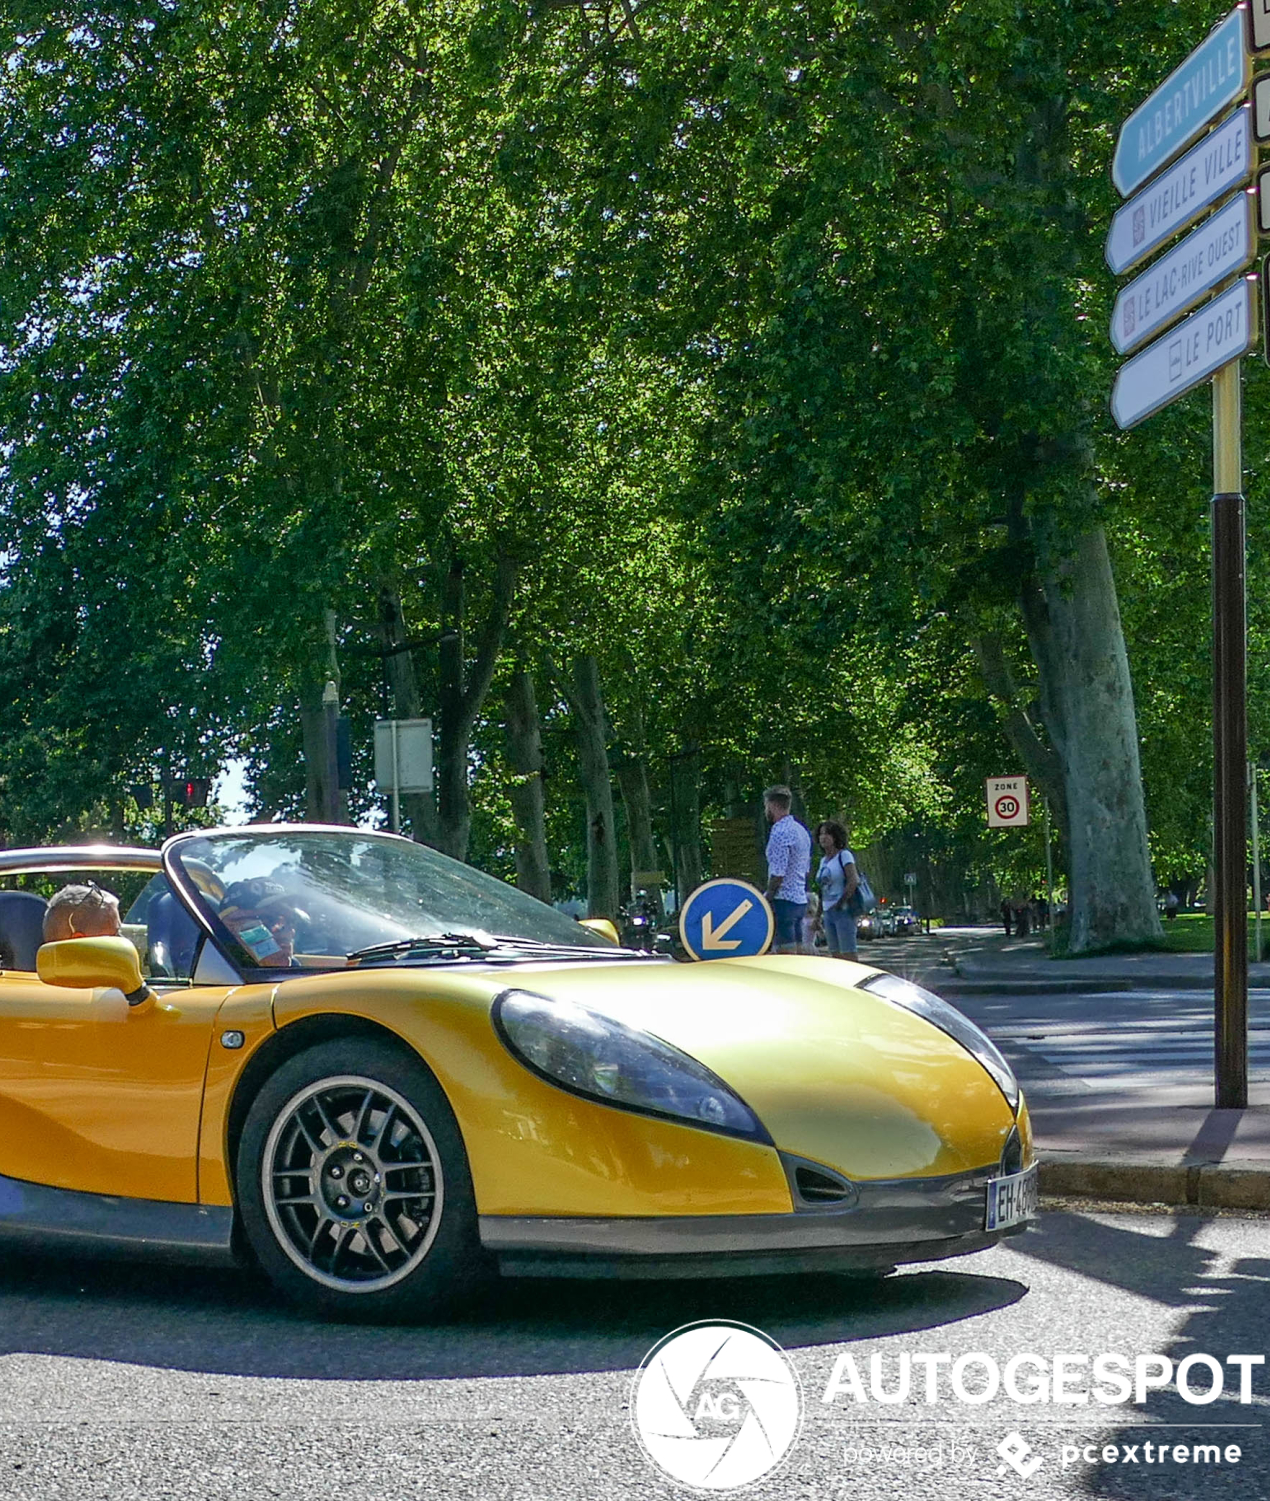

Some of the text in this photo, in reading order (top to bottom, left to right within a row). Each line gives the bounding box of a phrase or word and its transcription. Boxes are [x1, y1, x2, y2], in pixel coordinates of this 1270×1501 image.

[1137, 36, 1237, 163] ALBERTVILLE
[1149, 129, 1243, 229] VIEILLE VILLE
[1137, 287, 1150, 322] LE
[1207, 220, 1242, 268] OUEST
[1185, 300, 1243, 367] LE PORT
[1000, 802, 1015, 812] 30
